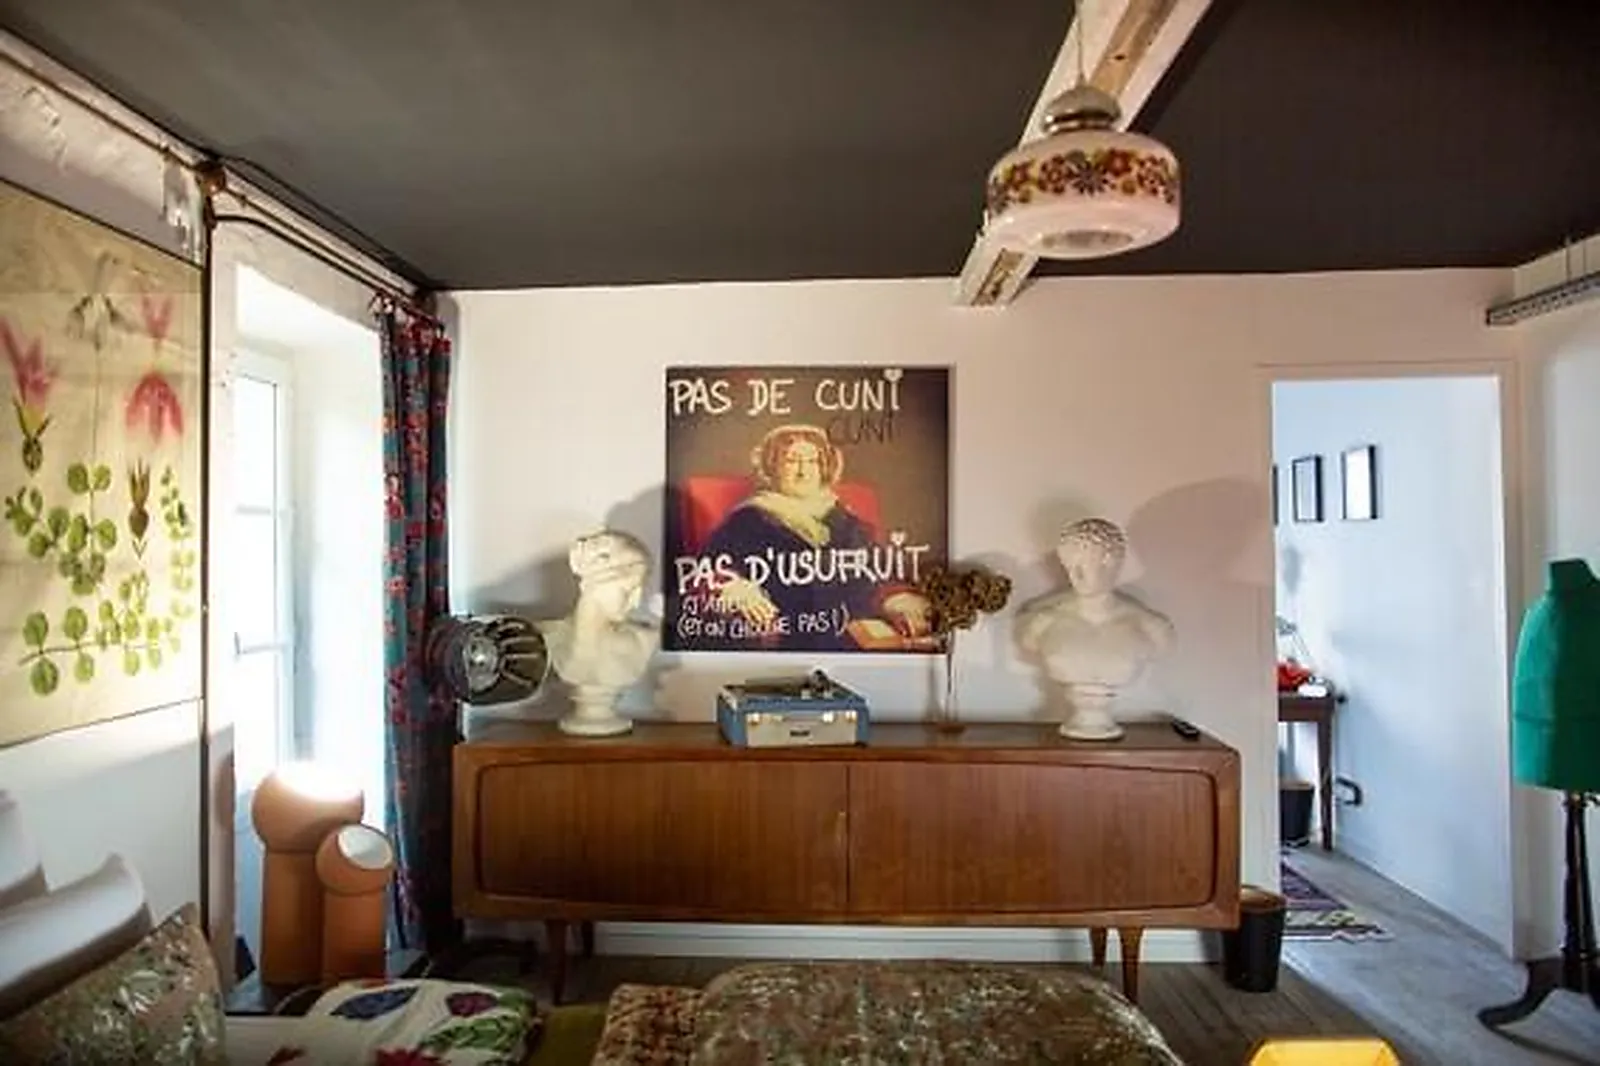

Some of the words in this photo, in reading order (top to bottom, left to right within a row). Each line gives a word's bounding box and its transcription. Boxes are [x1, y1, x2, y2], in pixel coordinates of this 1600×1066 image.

[668, 377, 733, 416] PAS
[747, 378, 795, 416] DE
[674, 554, 742, 595] PAS
